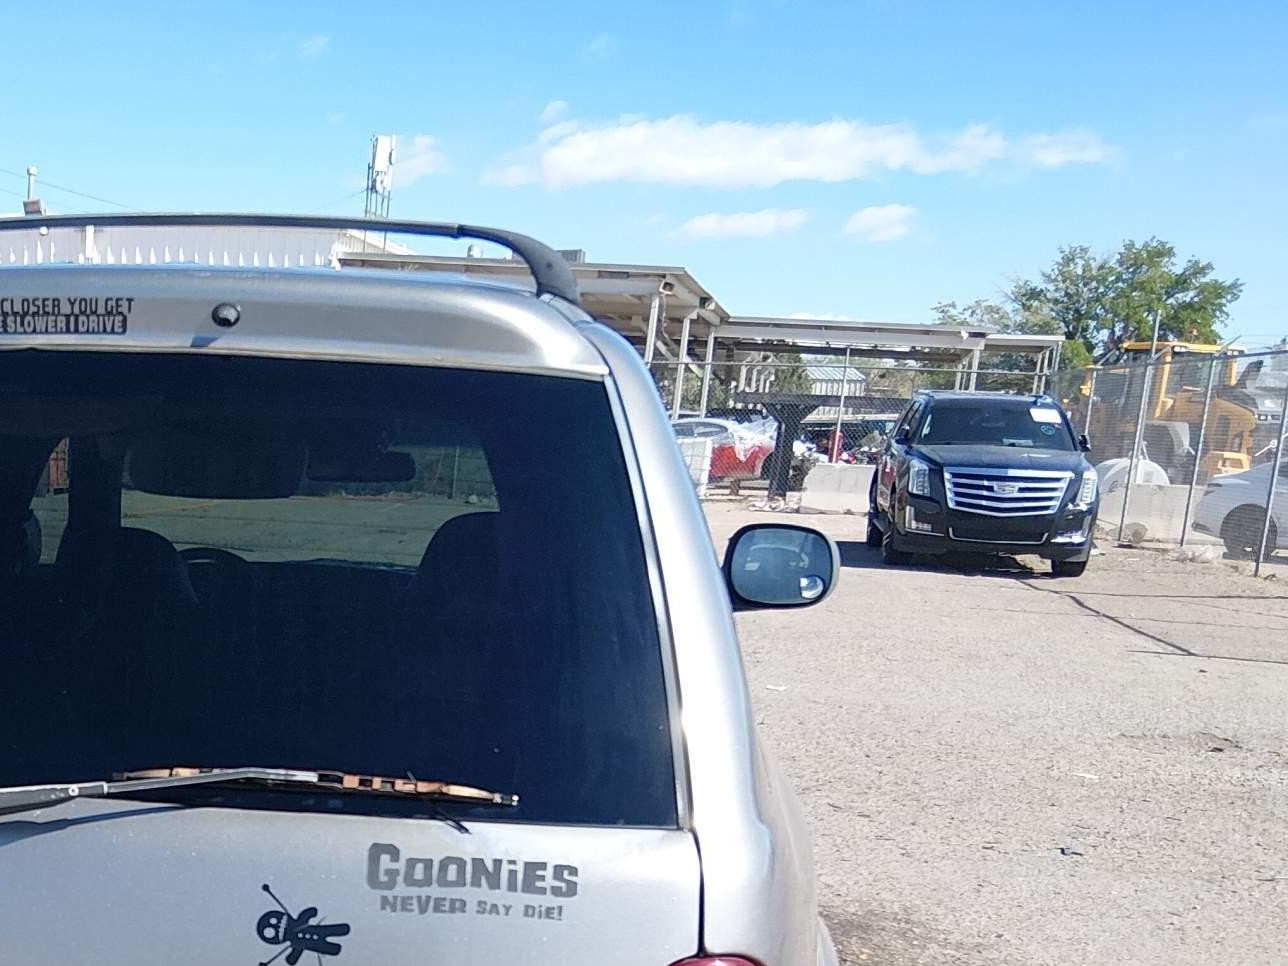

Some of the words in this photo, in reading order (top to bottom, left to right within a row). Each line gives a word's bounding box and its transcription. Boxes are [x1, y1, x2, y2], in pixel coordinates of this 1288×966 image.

[0, 297, 61, 315] CLOSER
[67, 297, 98, 314] YOU
[104, 297, 134, 314] GET
[6, 315, 66, 333] SLOWER
[69, 315, 75, 333] I
[77, 315, 124, 333] DRIVE
[380, 895, 467, 915] NEVER
[475, 900, 513, 916] SAY
